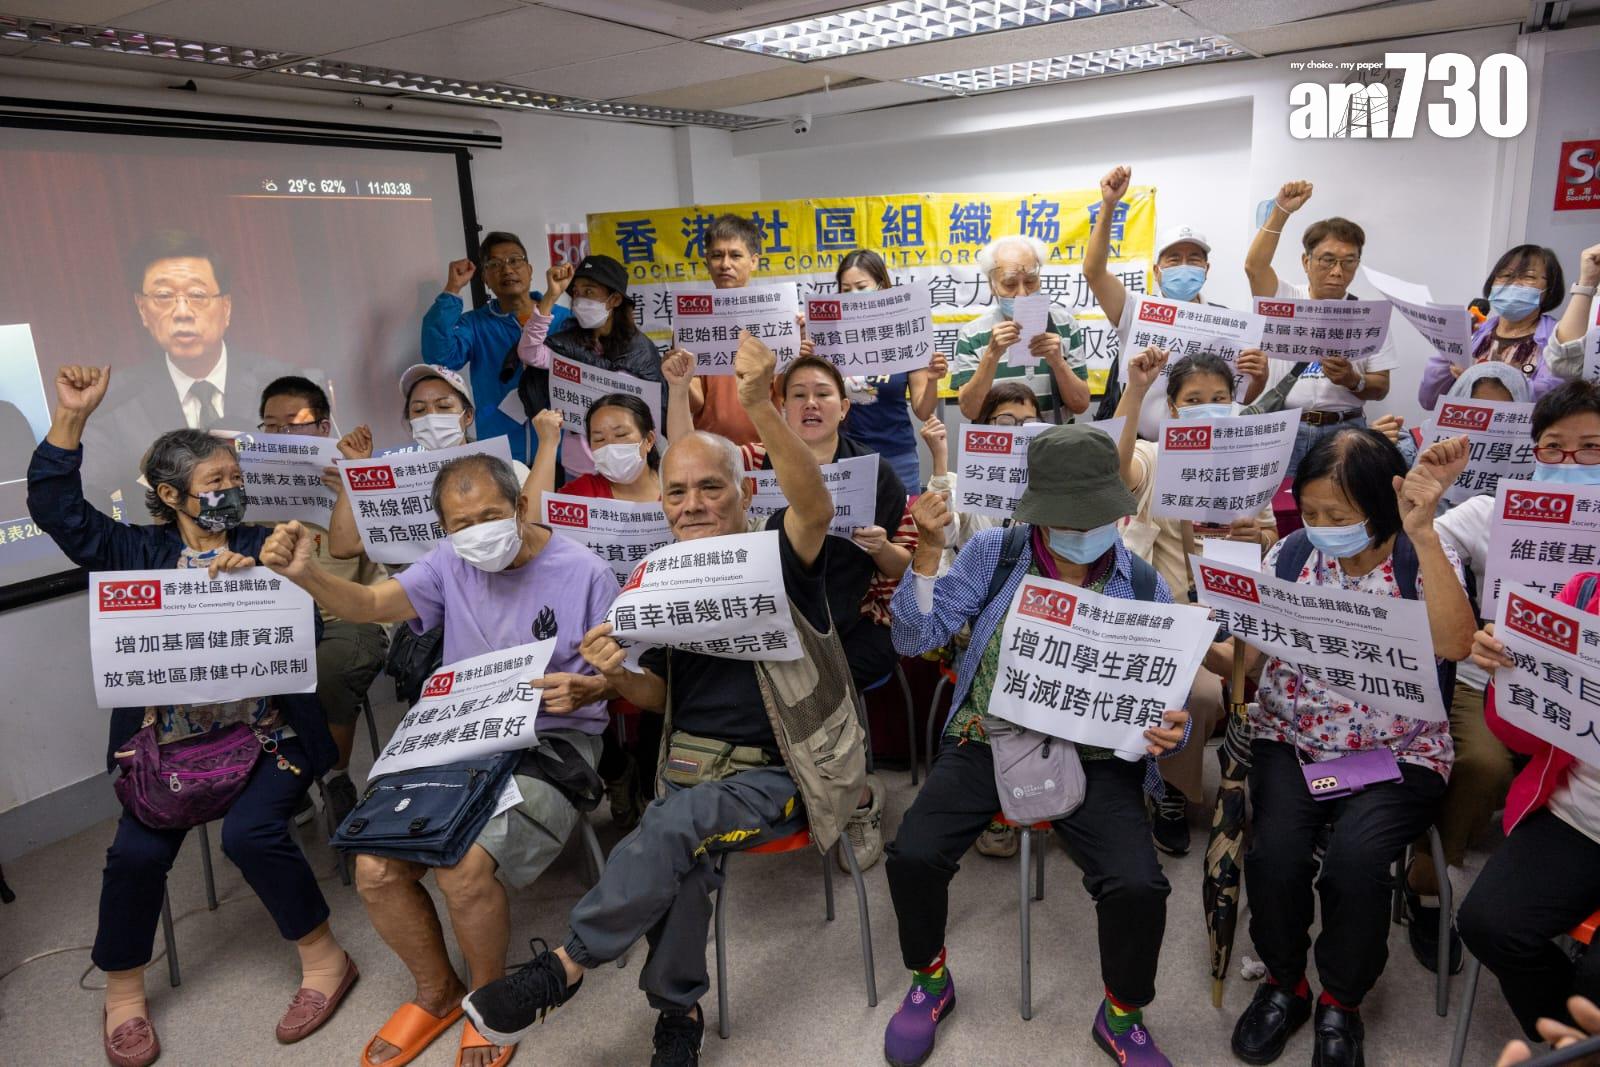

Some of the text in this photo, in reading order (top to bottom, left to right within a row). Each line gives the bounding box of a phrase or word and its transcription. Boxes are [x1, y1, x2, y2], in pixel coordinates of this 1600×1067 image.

[320, 179, 346, 193] 62%
[367, 181, 412, 195] 11:03:38
[679, 297, 709, 308] SoCO
[1143, 304, 1173, 318] SoCO
[1445, 406, 1488, 424] SoCO
[968, 433, 1008, 447] SoCO
[1168, 429, 1207, 442] SoCO
[349, 469, 389, 483] SoCO
[1181, 460, 1280, 483] 學校託管要增加
[550, 503, 584, 519] SoCO
[1509, 493, 1567, 513] SoCO
[646, 548, 749, 574] 香港社區組織協會
[163, 578, 283, 596] 香港社區組織協會
[661, 578, 671, 587] for
[670, 577, 703, 587] Community
[1204, 568, 1252, 593] SoCO
[102, 584, 156, 601] SoCO
[1026, 588, 1071, 614] SoCO
[1258, 583, 1389, 620] 香港社區組織協會
[198, 600, 235, 609] Community
[604, 593, 778, 632] 層幸福幾時有
[1077, 602, 1175, 630] 香港社區組織協會
[1512, 599, 1573, 640] SoCO
[114, 626, 295, 655] 增加基層健康資源
[455, 654, 534, 683] 香港社區組織協會
[1009, 626, 1178, 688] 增加學生資助
[103, 658, 308, 688] 放寬地區康健中心限制
[401, 681, 534, 730] 增建公屋土地足
[1002, 665, 1167, 729] 消滅跨代貧窮
